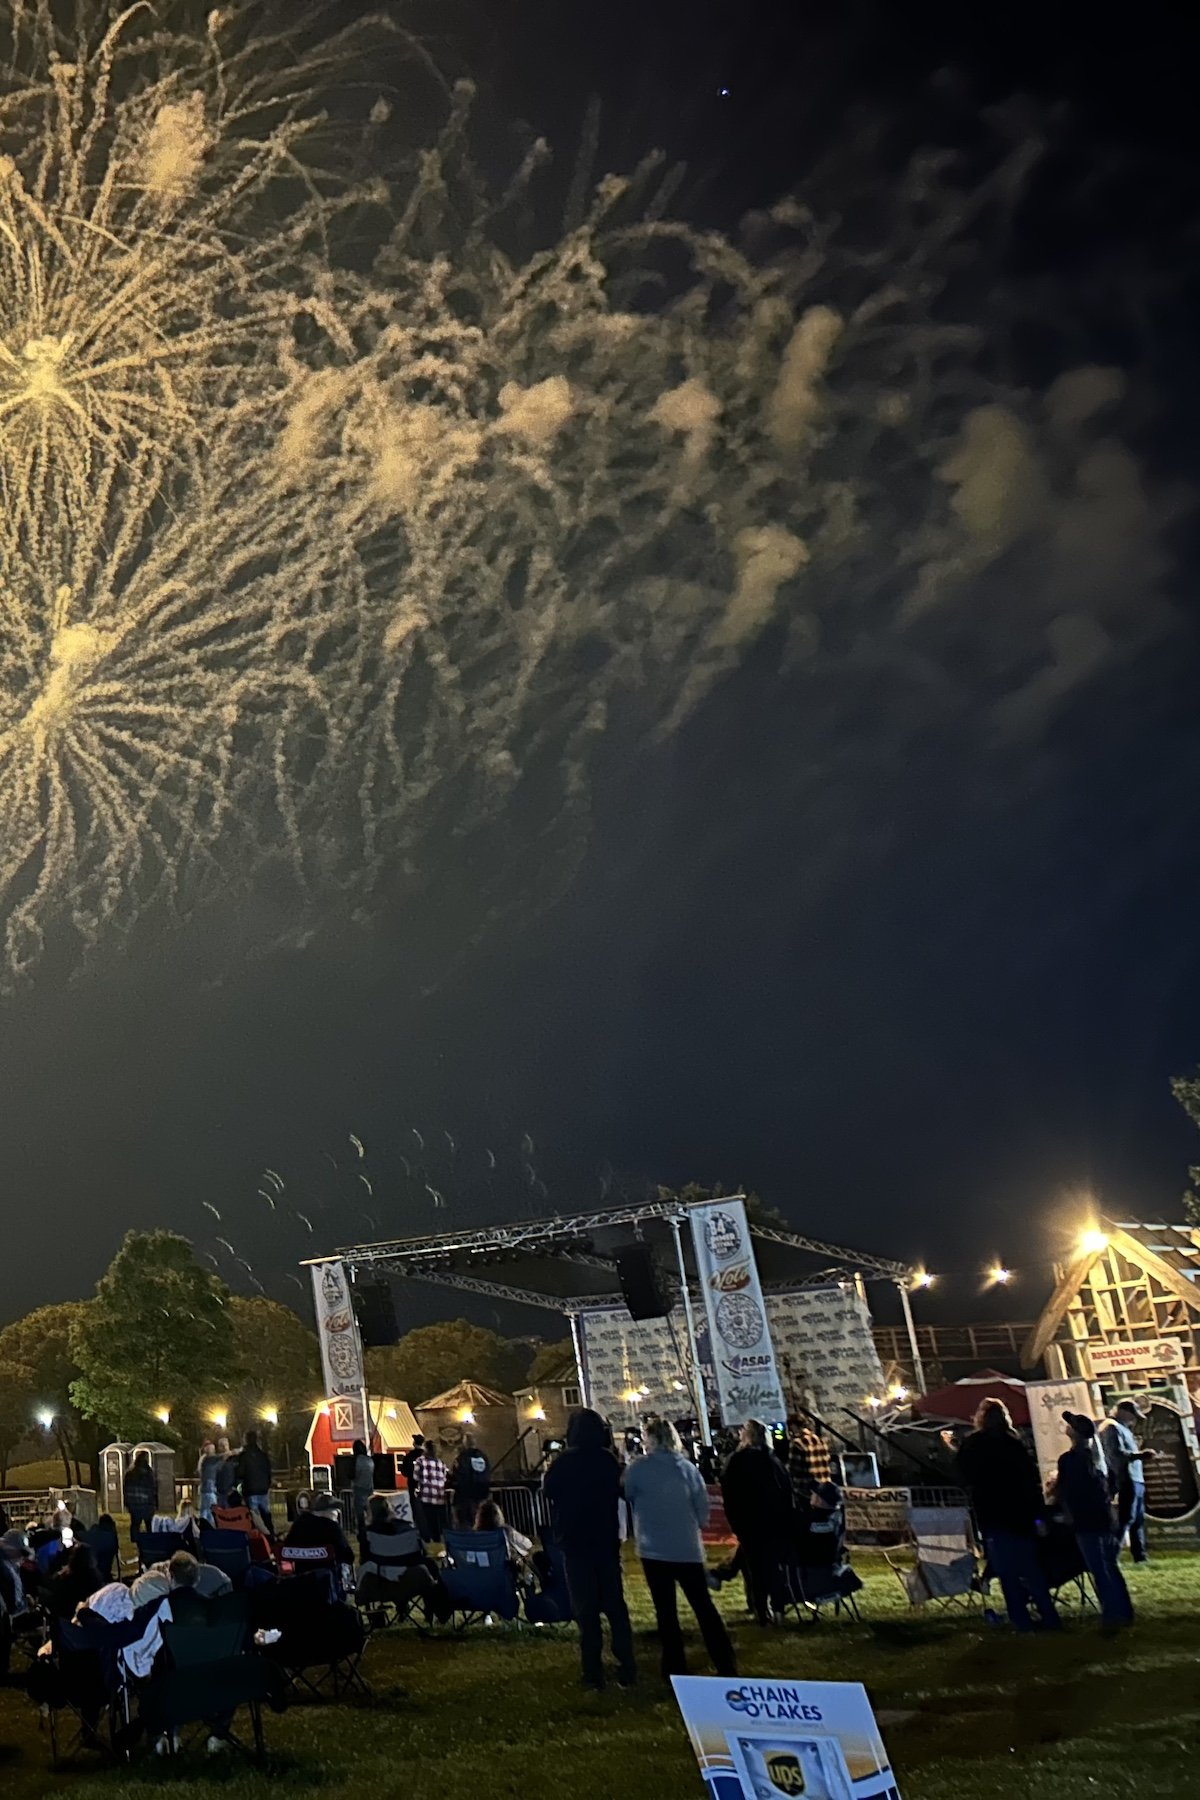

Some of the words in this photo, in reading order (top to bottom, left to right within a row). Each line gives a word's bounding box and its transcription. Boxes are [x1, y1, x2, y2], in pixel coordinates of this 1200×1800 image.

[1091, 1346, 1150, 1360] RICHARDSON
[741, 1355, 771, 1367] ASAP
[1110, 1358, 1135, 1367] FARM
[345, 1383, 360, 1393] ASA
[740, 1686, 800, 1703] CHAIN
[746, 1702, 823, 1721] O'LAKES
[769, 1763, 802, 1792] ups
